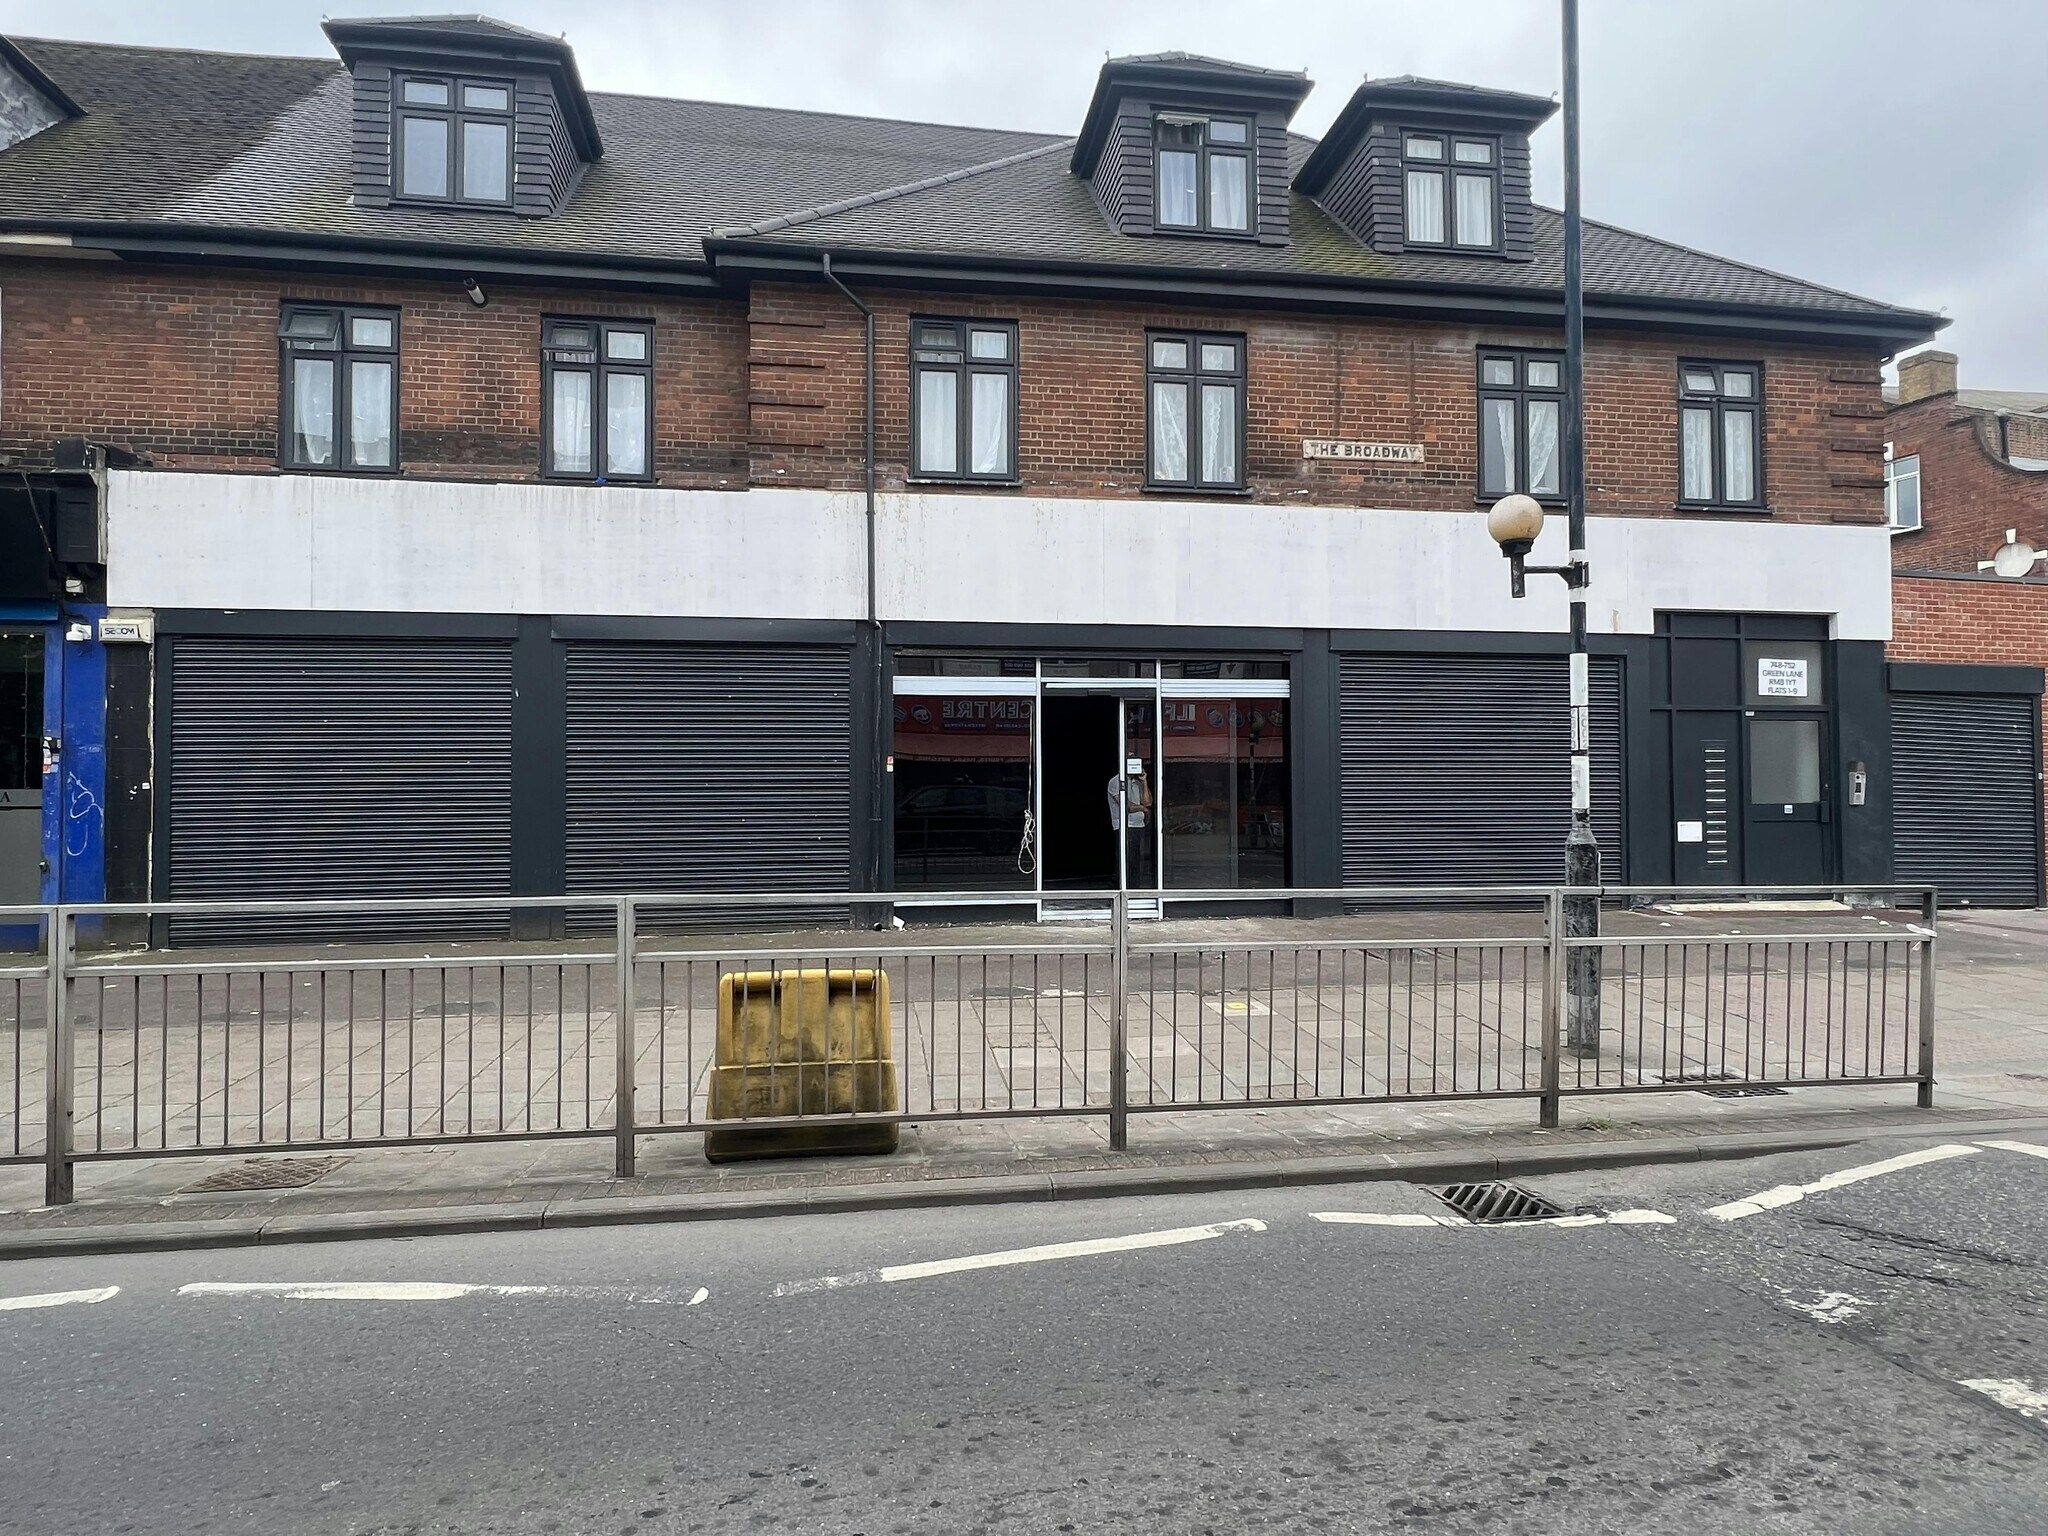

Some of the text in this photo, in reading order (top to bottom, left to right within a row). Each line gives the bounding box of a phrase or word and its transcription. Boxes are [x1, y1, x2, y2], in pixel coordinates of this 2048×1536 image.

[1310, 443, 1417, 459] THE BROADWAY
[1762, 669, 1804, 678] GREEN LANE
[1767, 686, 1787, 694] FLATS
